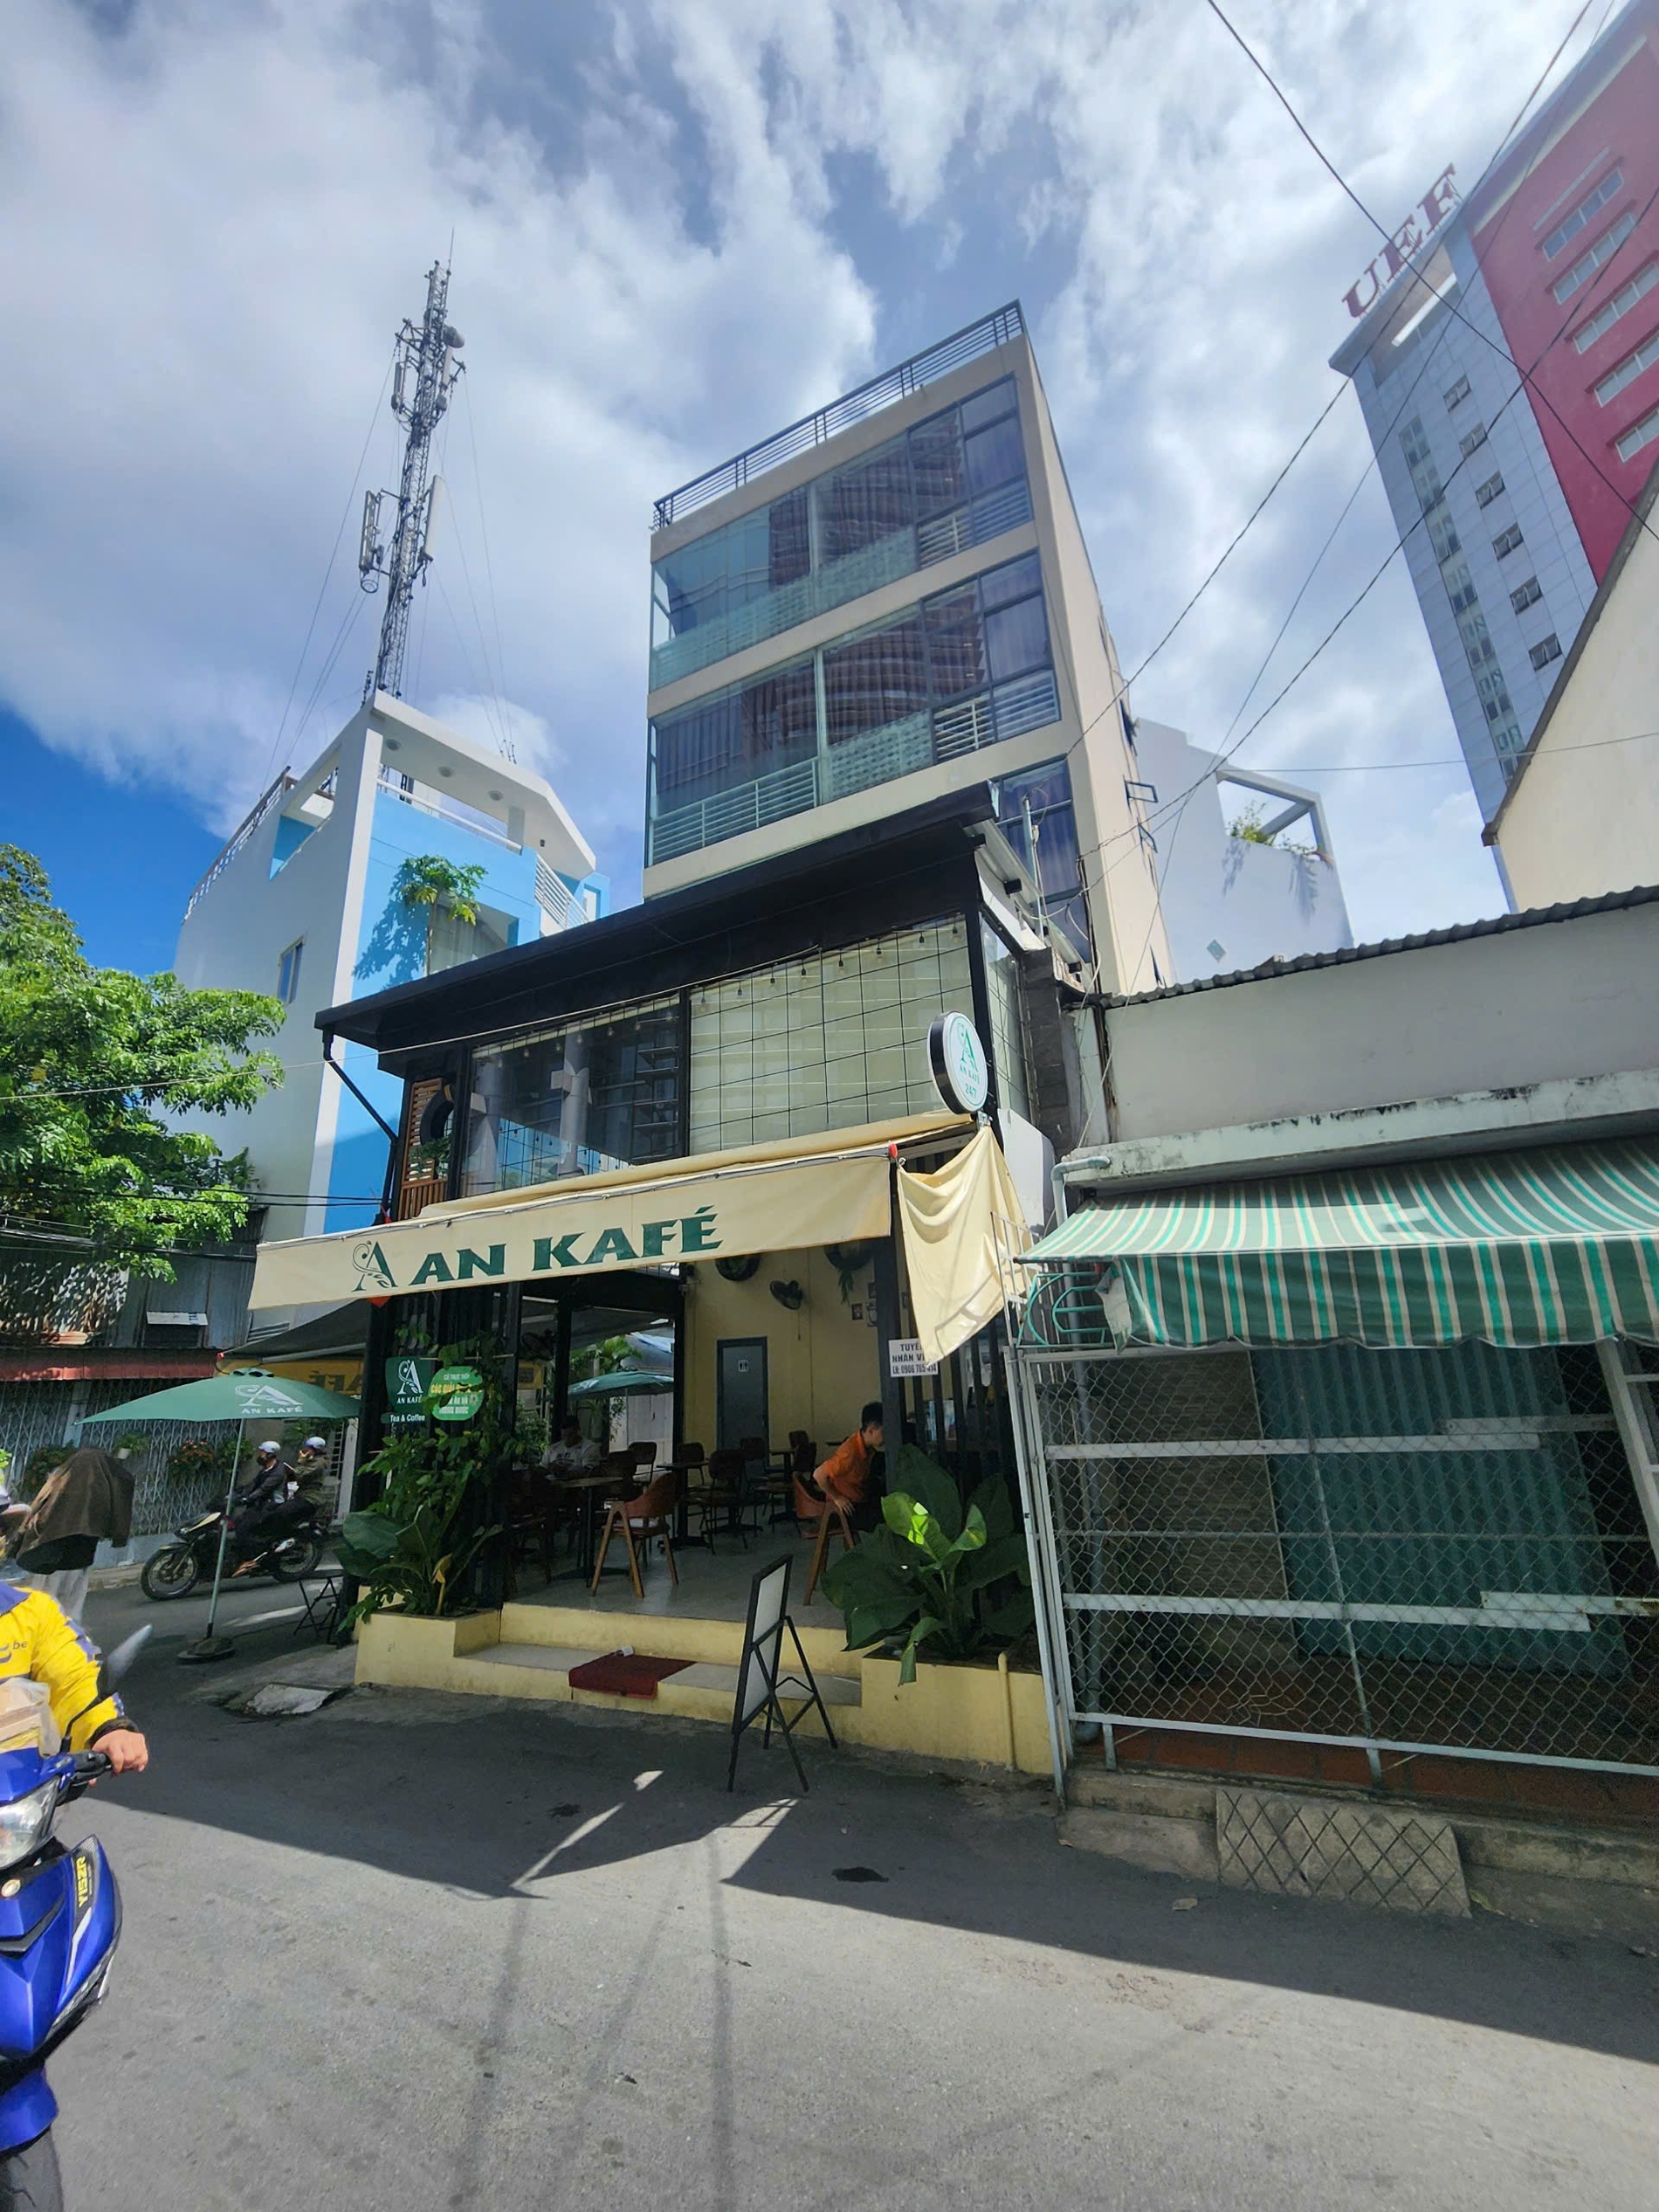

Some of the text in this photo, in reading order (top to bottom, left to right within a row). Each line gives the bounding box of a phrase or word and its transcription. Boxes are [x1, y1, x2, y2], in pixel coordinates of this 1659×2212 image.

[1341, 162, 1456, 318] UEF
[408, 1243, 506, 1286] AN
[532, 1205, 724, 1271] KAFÉ
[266, 1405, 304, 1414] KAFÉ
[406, 1413, 425, 1422] Coffee
[12, 1640, 29, 1650] be
